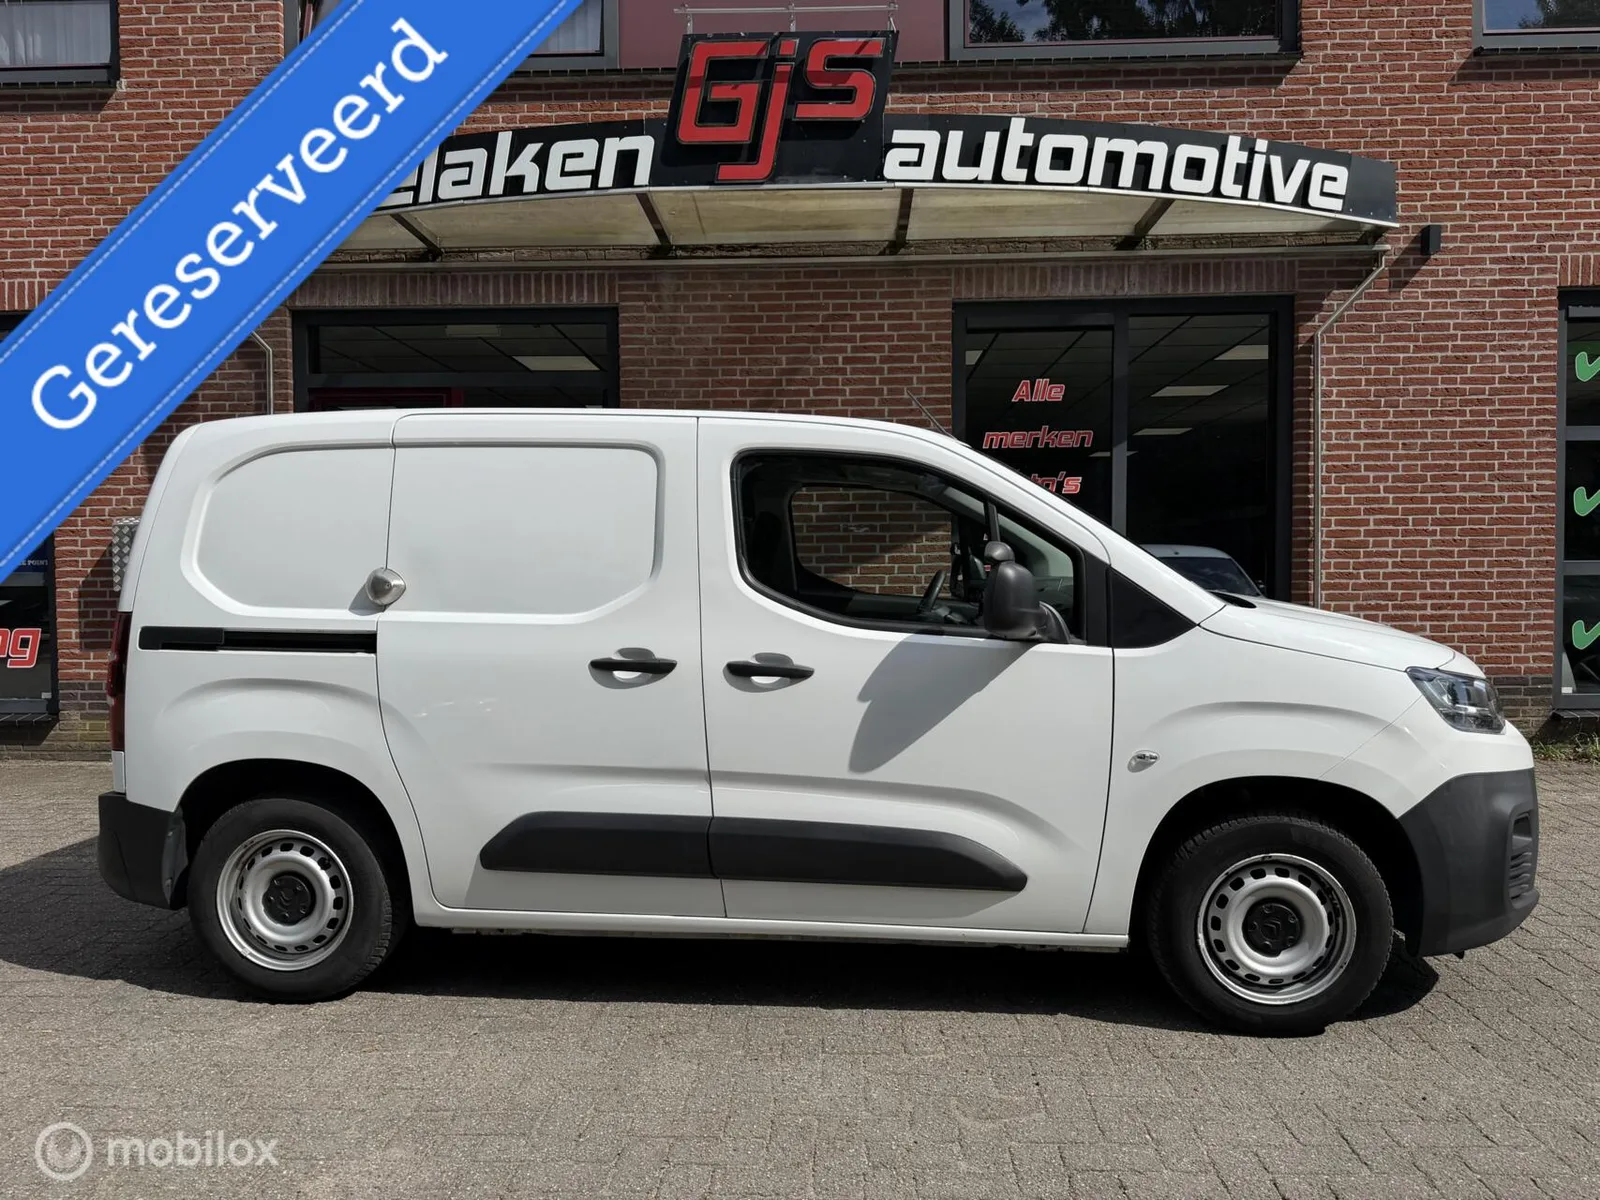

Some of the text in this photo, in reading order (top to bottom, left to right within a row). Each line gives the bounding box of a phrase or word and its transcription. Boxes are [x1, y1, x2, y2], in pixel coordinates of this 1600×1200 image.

[882, 117, 1349, 212] automotive
[1011, 378, 1066, 402] Alle
[982, 425, 1094, 449] merken
